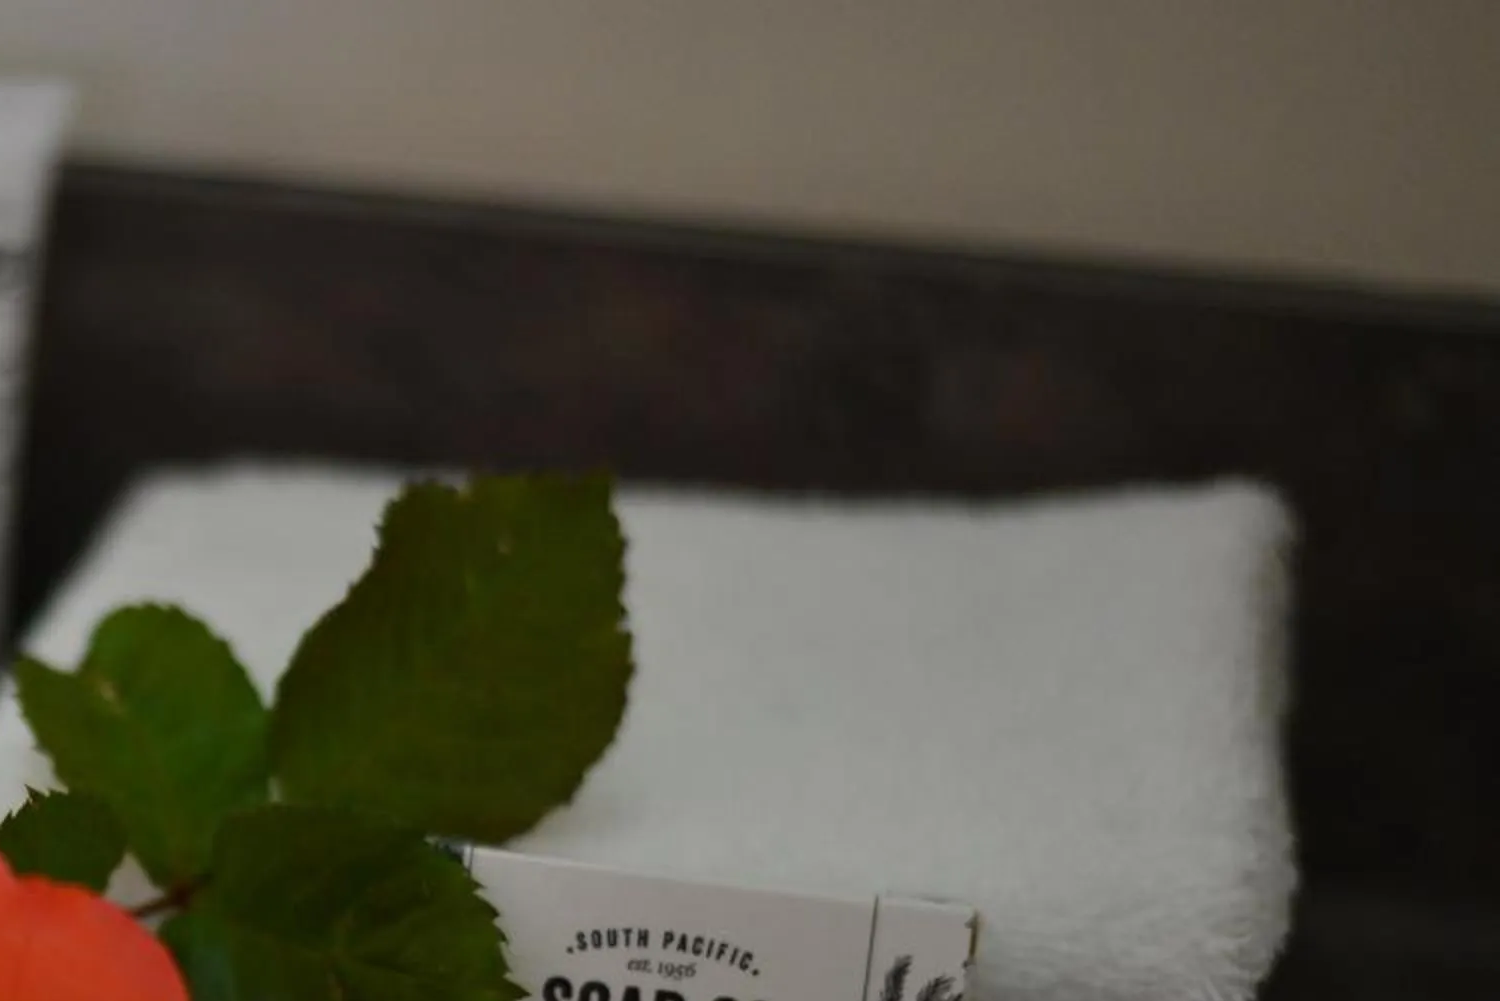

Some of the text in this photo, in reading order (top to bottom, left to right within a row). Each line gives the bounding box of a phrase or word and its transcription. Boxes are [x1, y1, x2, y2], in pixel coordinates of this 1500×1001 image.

[575, 928, 754, 971] SOUTH PACIFIC
[657, 960, 698, 980] 1956
